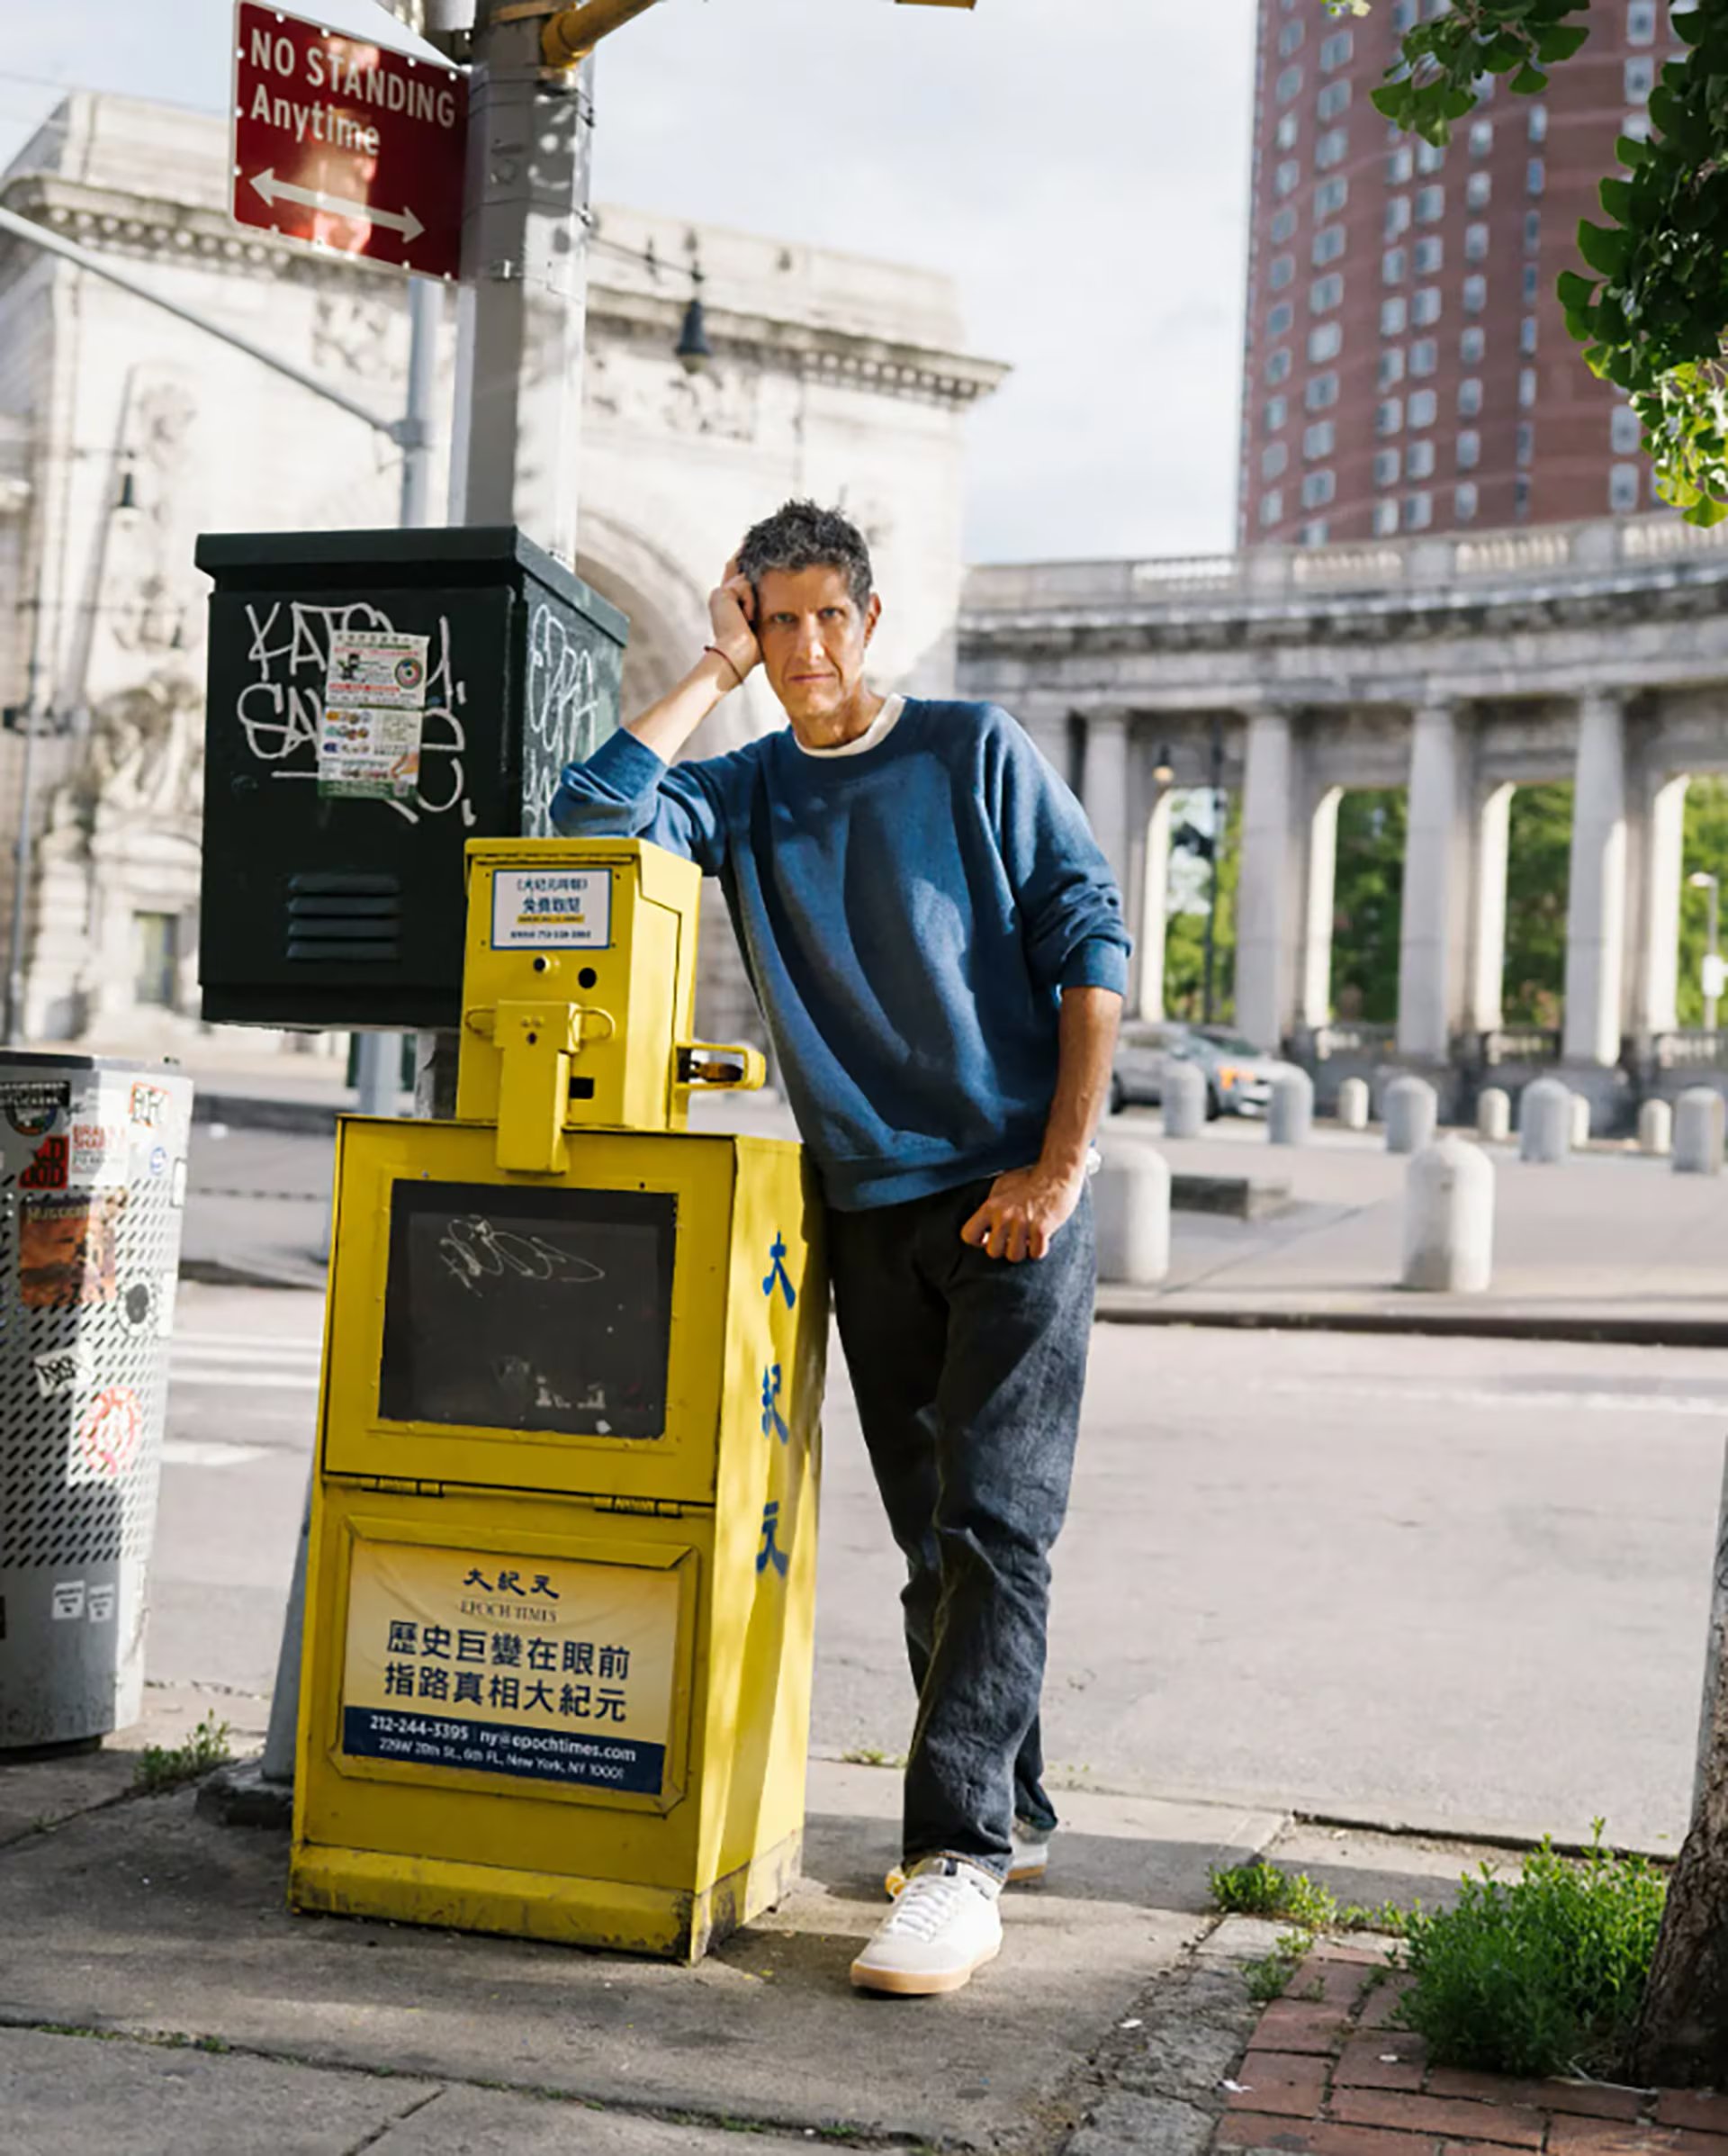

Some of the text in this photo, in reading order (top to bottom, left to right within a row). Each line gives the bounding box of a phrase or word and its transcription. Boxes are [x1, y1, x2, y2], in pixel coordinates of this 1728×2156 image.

[251, 28, 455, 128] NO STANDING
[249, 83, 381, 156] Anytime
[463, 1567, 561, 1601] 大紀元
[460, 1599, 558, 1623] EPOCH TIMES
[384, 1661, 627, 1723] 指路真相大紀元
[480, 1729, 637, 1763] ny@epochtimes.com
[506, 1753, 534, 1769] New
[568, 1760, 586, 1774] NY
